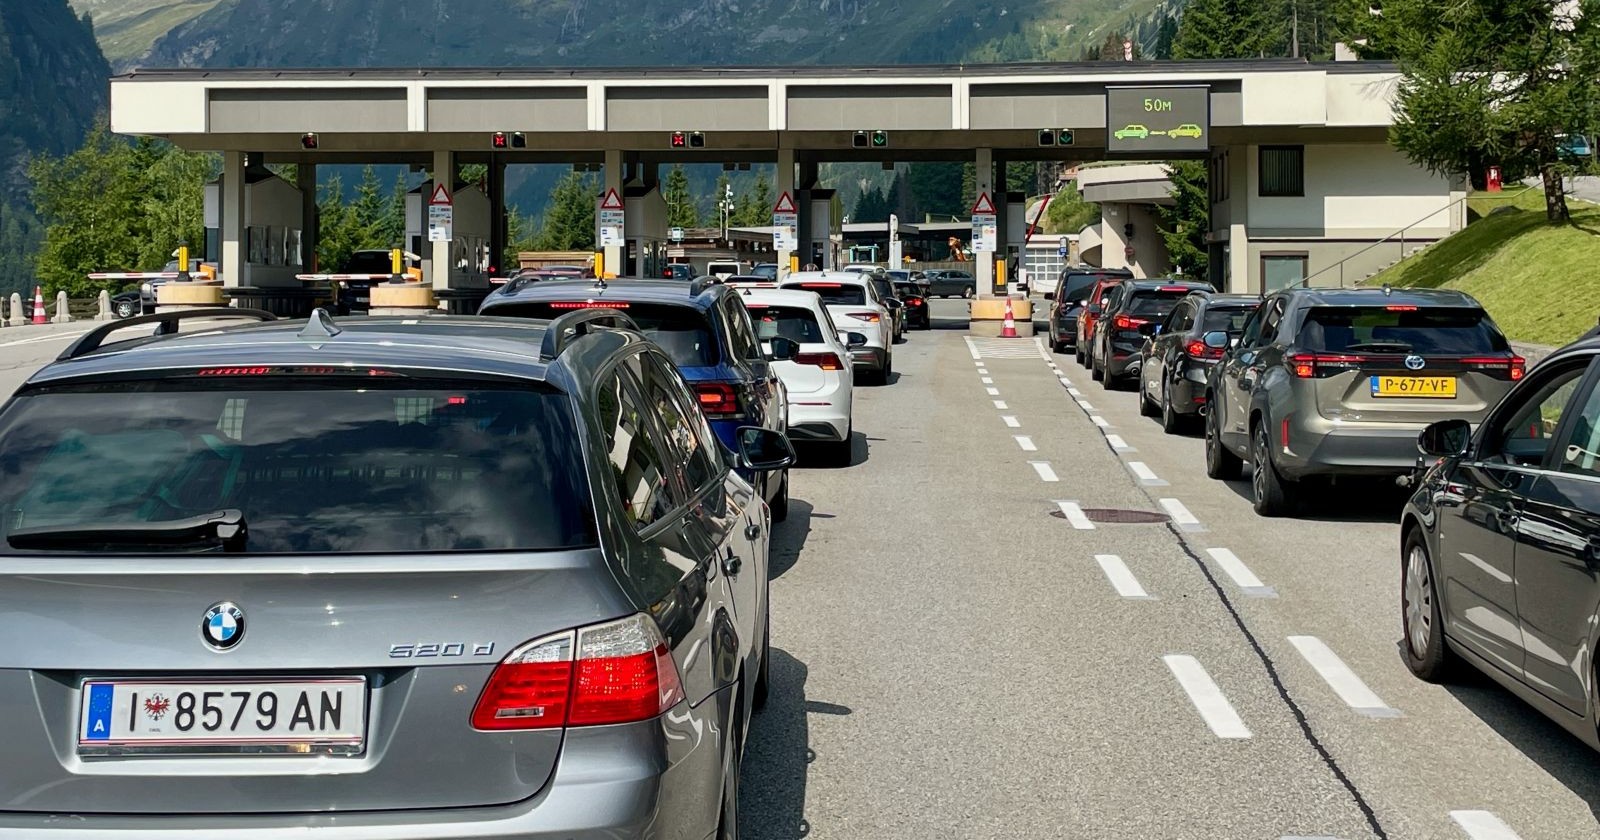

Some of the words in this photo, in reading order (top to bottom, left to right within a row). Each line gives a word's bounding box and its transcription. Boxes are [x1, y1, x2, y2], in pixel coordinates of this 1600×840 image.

[1144, 98, 1172, 112] 50M
[1385, 378, 1448, 392] P-677-VF
[206, 603, 242, 620] BMW
[389, 642, 465, 658] 520
[129, 692, 138, 732] I
[174, 691, 278, 732] 8579
[289, 690, 342, 731] AN
[93, 718, 105, 733] A
